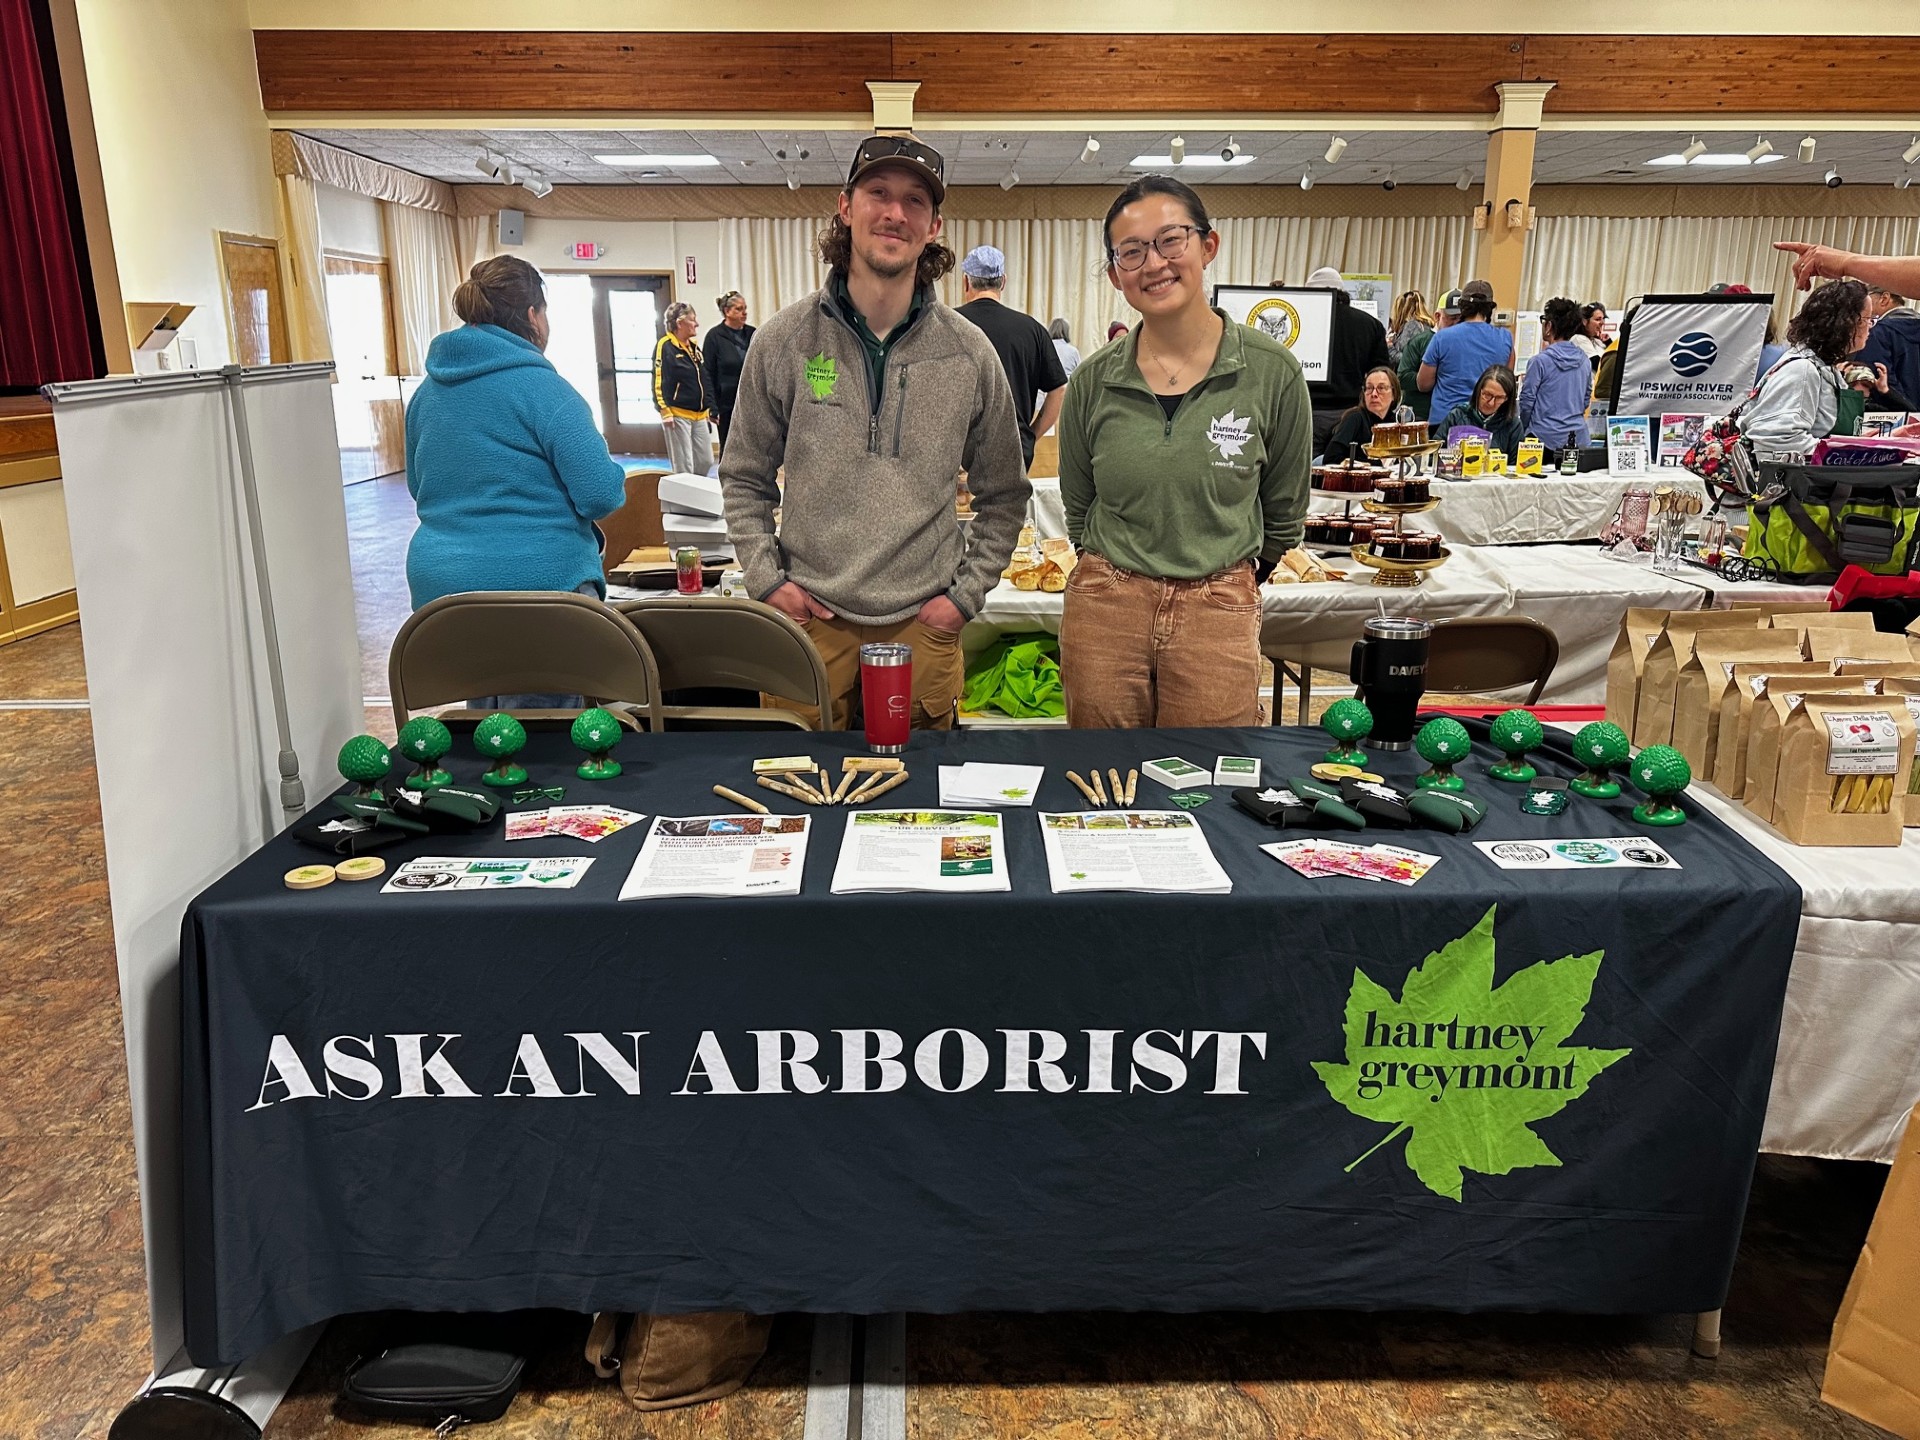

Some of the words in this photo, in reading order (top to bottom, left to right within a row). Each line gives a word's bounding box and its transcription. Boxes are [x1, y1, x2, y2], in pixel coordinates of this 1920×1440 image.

[576, 243, 594, 258] EXIT
[1300, 359, 1322, 369] ison
[1639, 382, 1692, 392] IPSWICH
[1695, 383, 1734, 393] RIVER
[1638, 392, 1682, 400] WATERSHED
[1683, 393, 1733, 401] ASSOCIATION
[1213, 424, 1241, 434] hartney
[1212, 432, 1247, 441] greymont
[1388, 665, 1425, 676] DAVEY
[1360, 1010, 1547, 1063] hartney
[244, 1033, 483, 1113] ASK
[493, 1031, 650, 1099] AN
[670, 1028, 1267, 1096] ARBORIST
[1357, 1054, 1580, 1103] greymont
